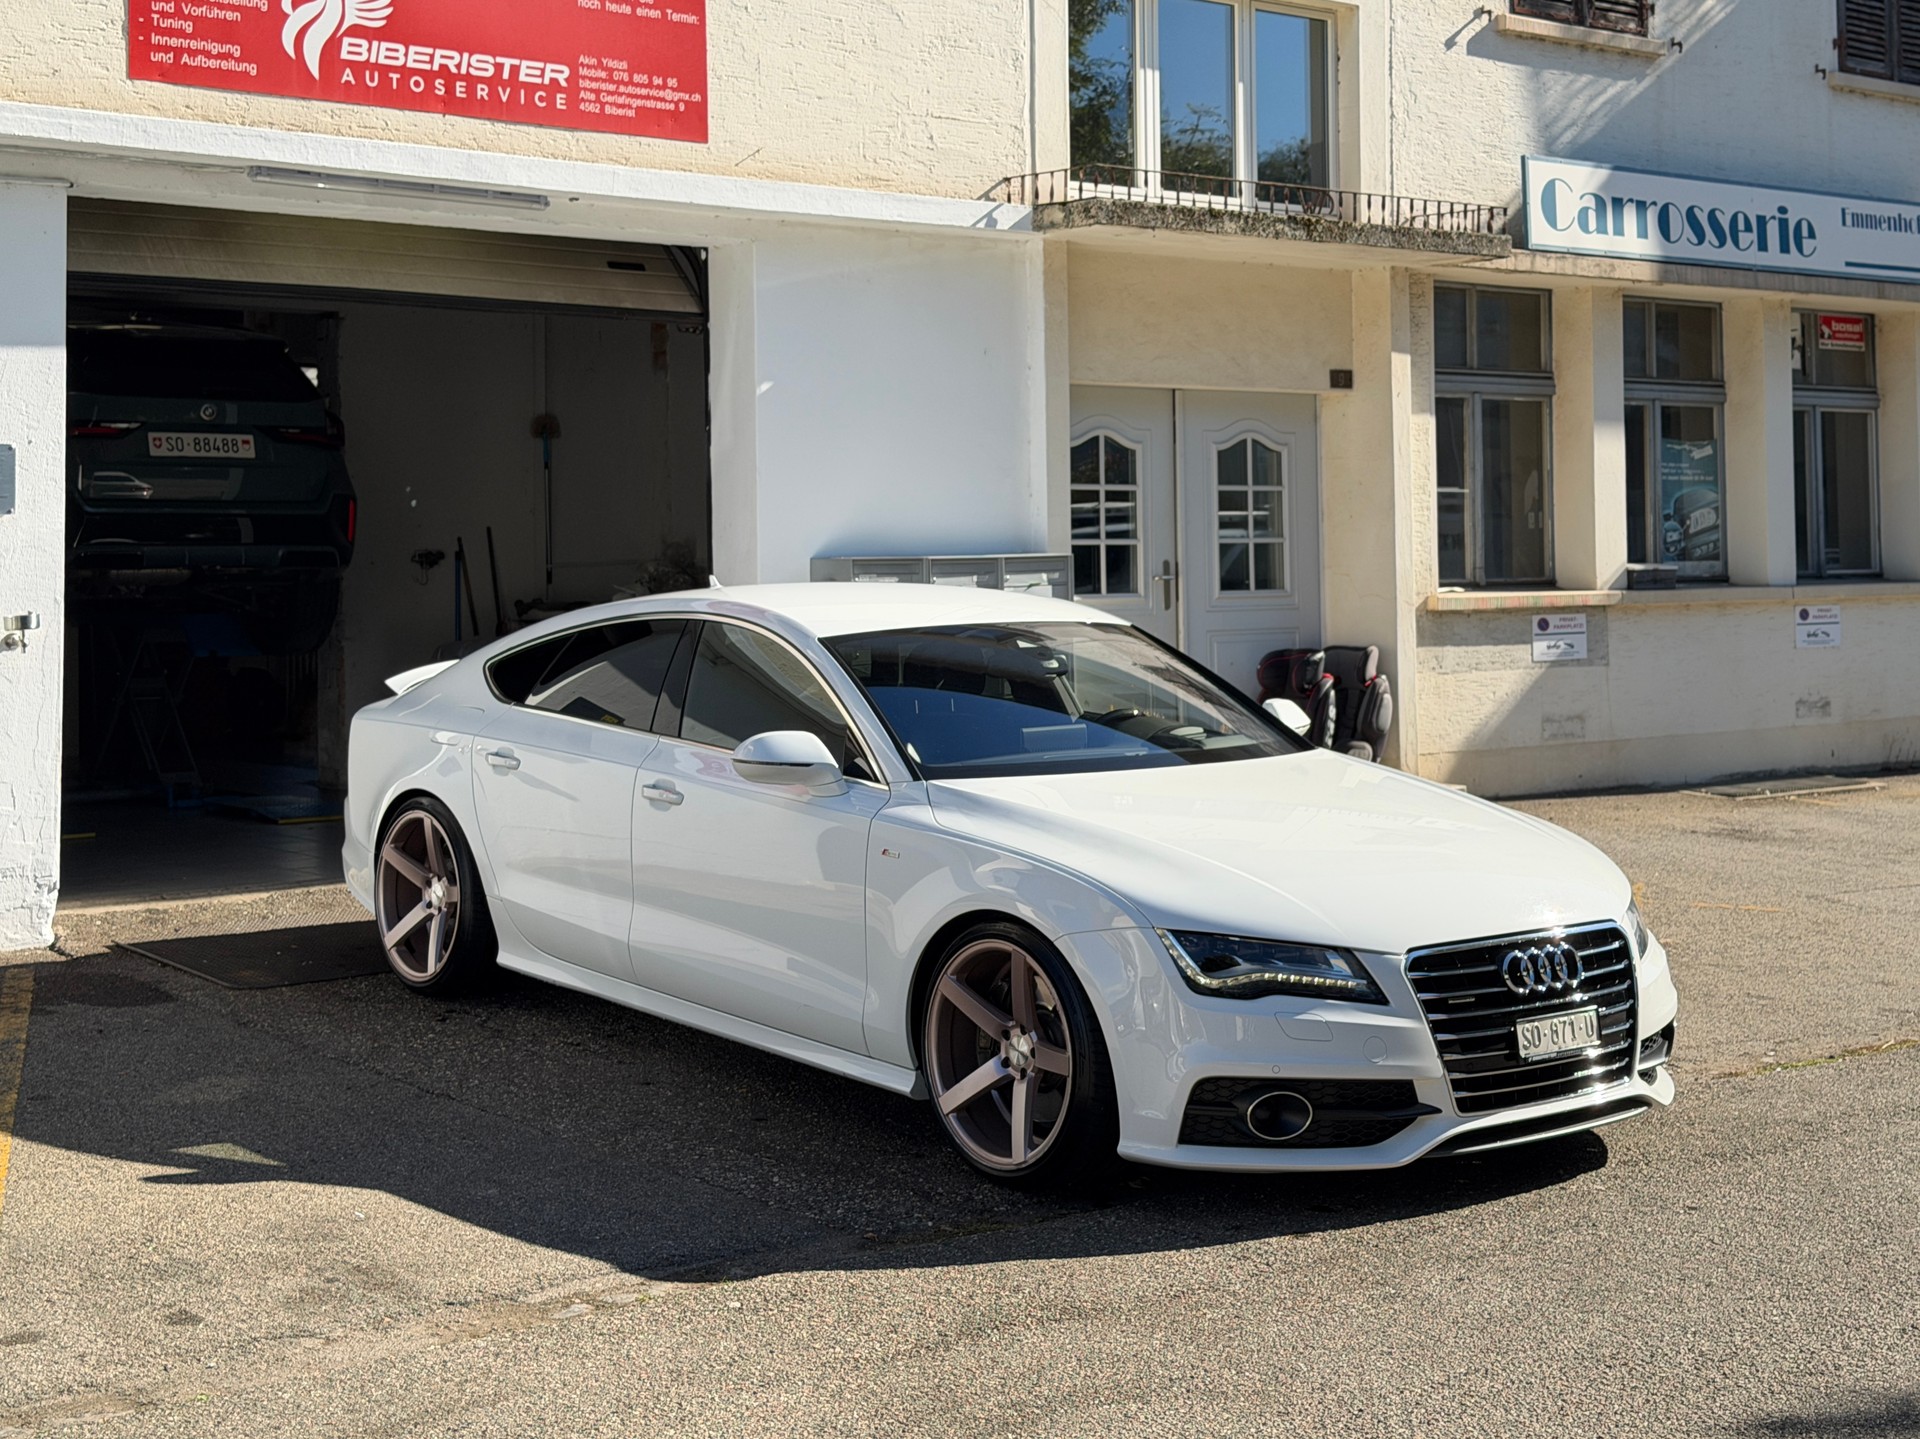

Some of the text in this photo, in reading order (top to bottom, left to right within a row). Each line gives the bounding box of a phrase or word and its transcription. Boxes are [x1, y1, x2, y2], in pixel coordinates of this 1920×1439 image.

[151, 1, 175, 13] und
[181, 2, 241, 22] Vorführen
[151, 13, 193, 33] Tuning
[577, 0, 700, 25] noch heute einen Termin:
[151, 32, 241, 57] Innenreinigung
[150, 51, 258, 76] und Aufbereitung
[340, 36, 571, 88] BIBERISTER
[578, 54, 598, 66] Akin
[340, 67, 567, 110] AUTOSERVICE
[578, 66, 678, 88] Mobile: 076 805 94 95
[578, 78, 702, 103] biberister.autoservice@gmx.ch
[578, 90, 596, 101] Alte
[678, 101, 685, 112] 9
[579, 102, 636, 118] 4562 Biberist
[1540, 177, 1818, 258] Carrosserie
